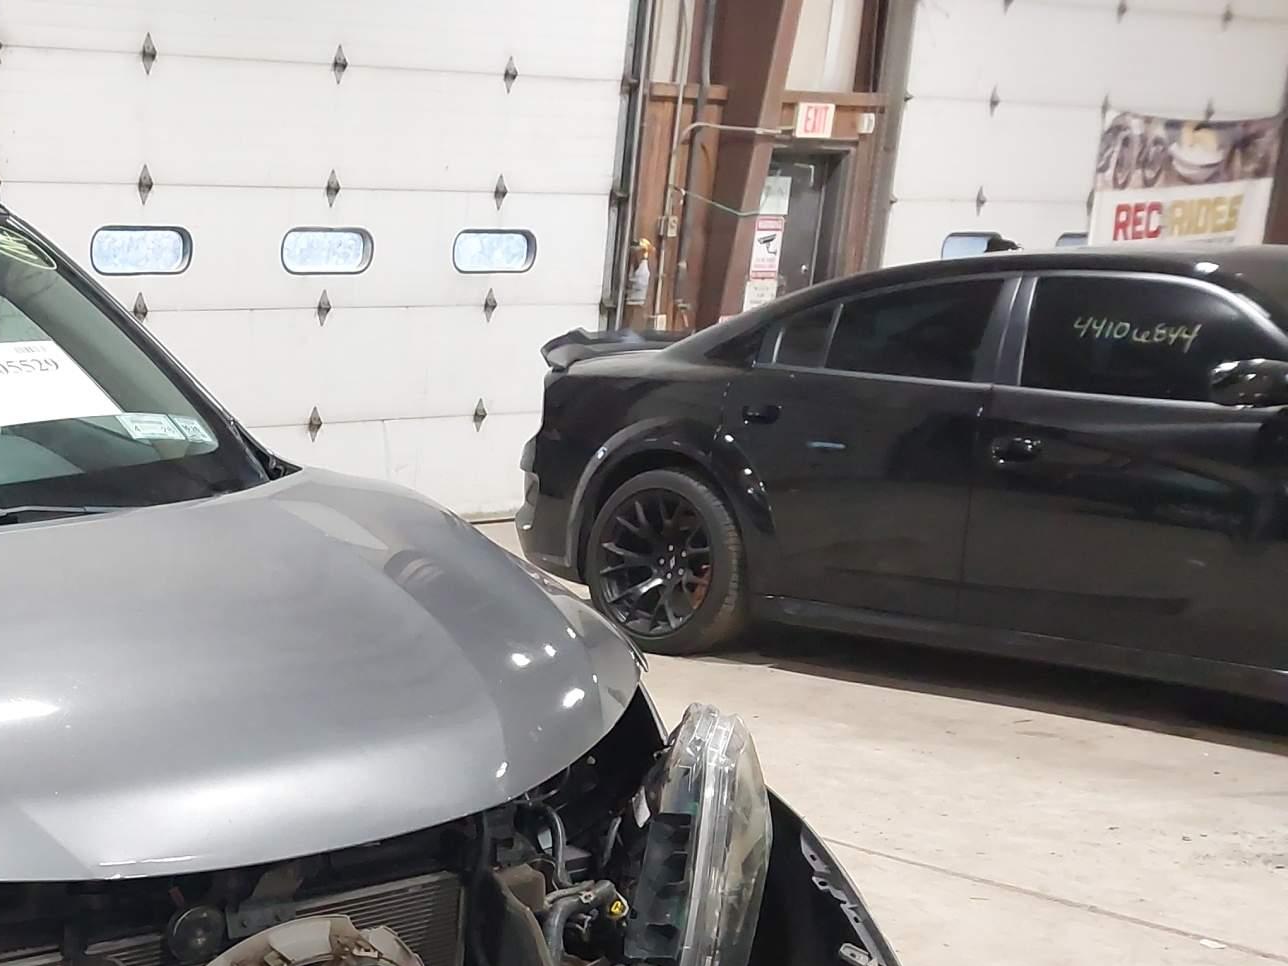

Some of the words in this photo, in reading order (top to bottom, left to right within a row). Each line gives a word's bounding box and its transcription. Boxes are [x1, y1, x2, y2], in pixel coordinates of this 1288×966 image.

[804, 105, 830, 133] EXIT
[1113, 201, 1162, 240] REC
[1168, 195, 1244, 236] RIDES
